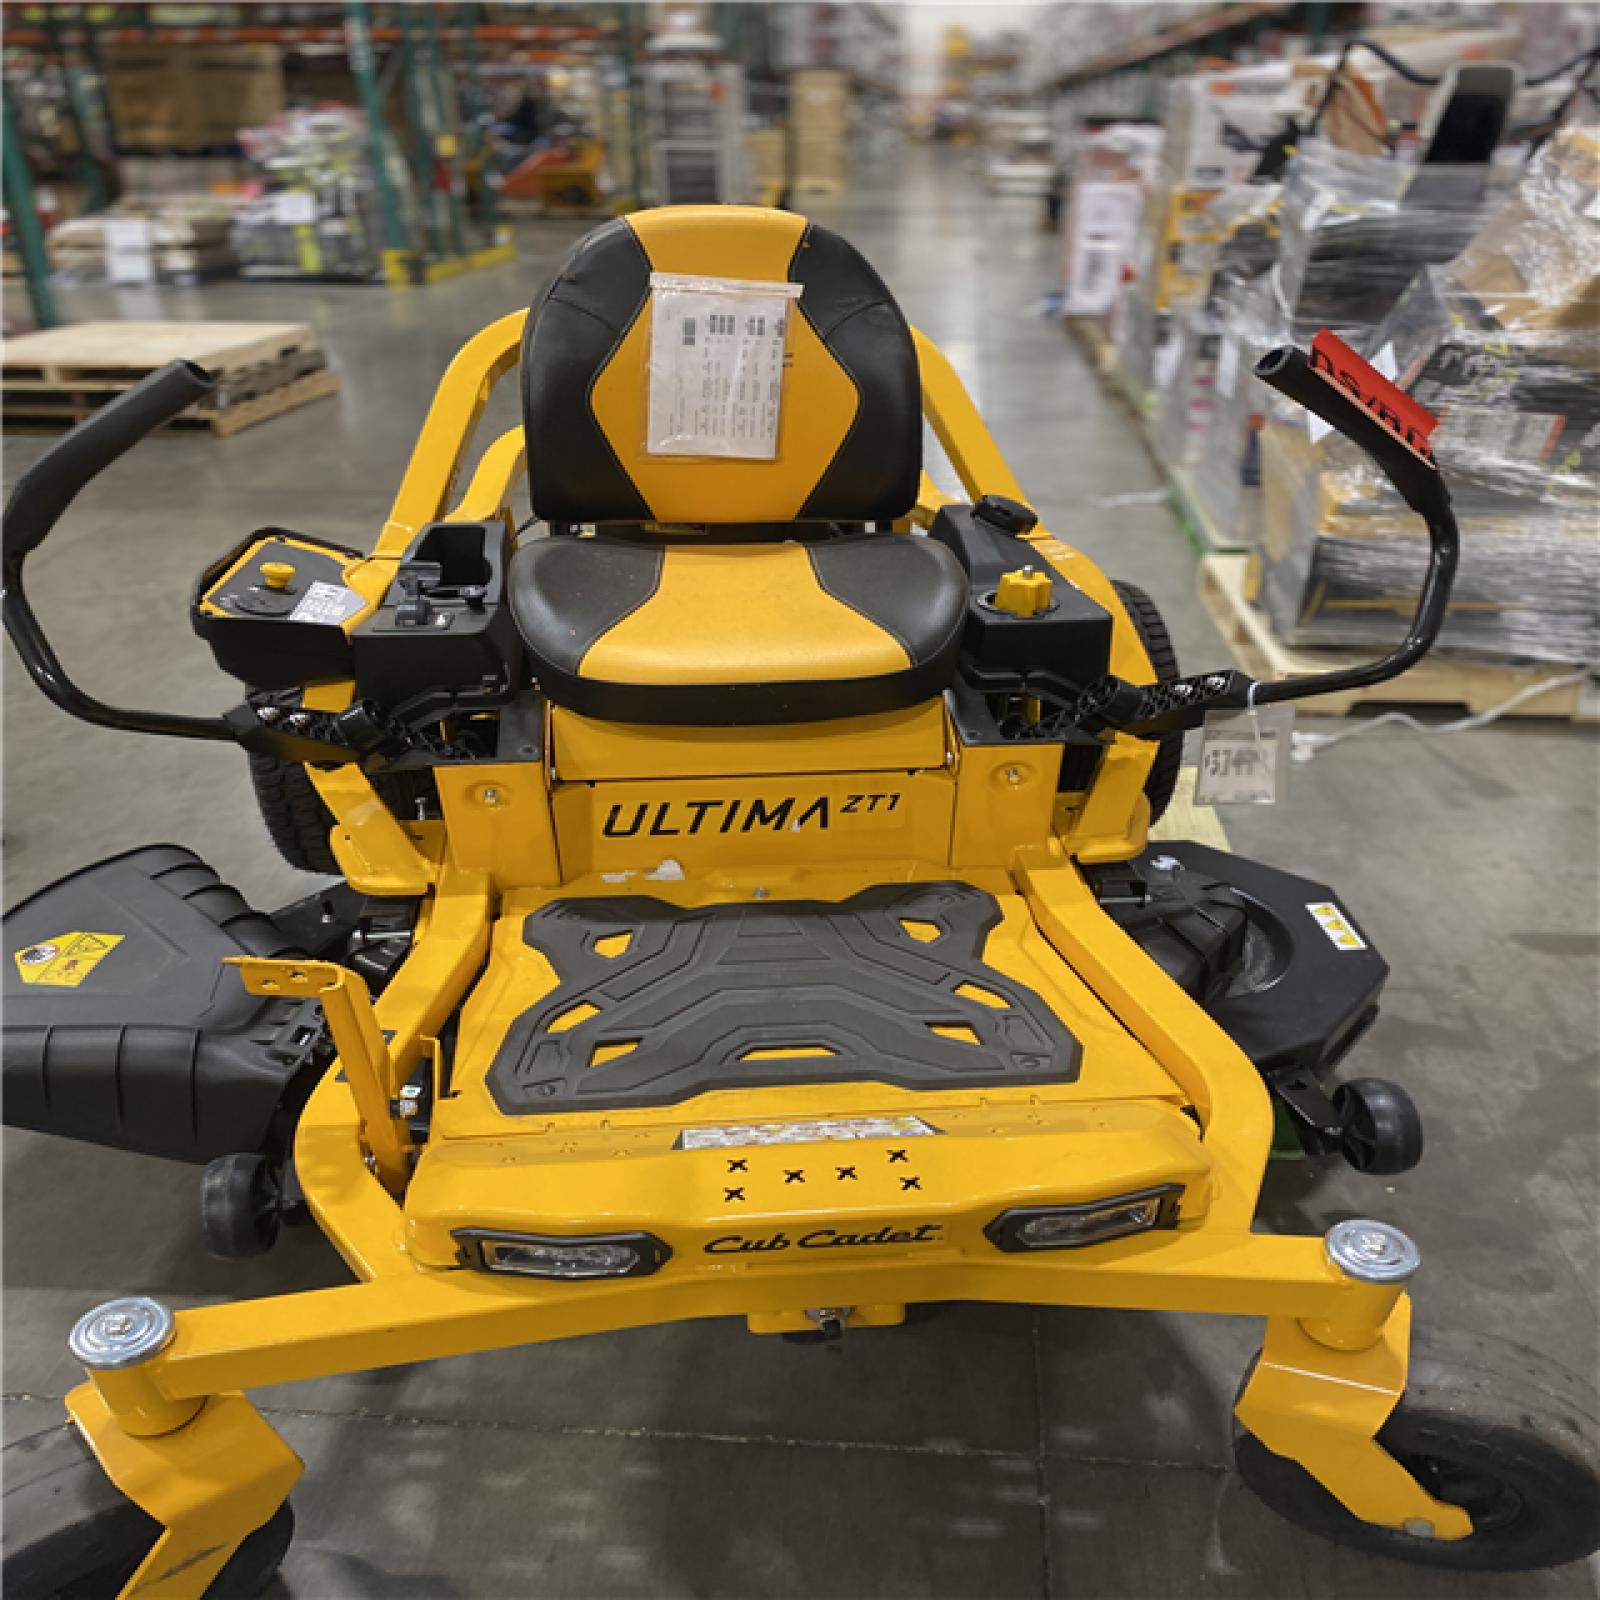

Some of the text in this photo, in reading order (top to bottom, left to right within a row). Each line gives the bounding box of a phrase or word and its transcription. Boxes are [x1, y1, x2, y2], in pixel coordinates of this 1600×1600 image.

[602, 793, 901, 836] ULTIMA ZT1
[703, 1224, 944, 1254] Cub Cadet
